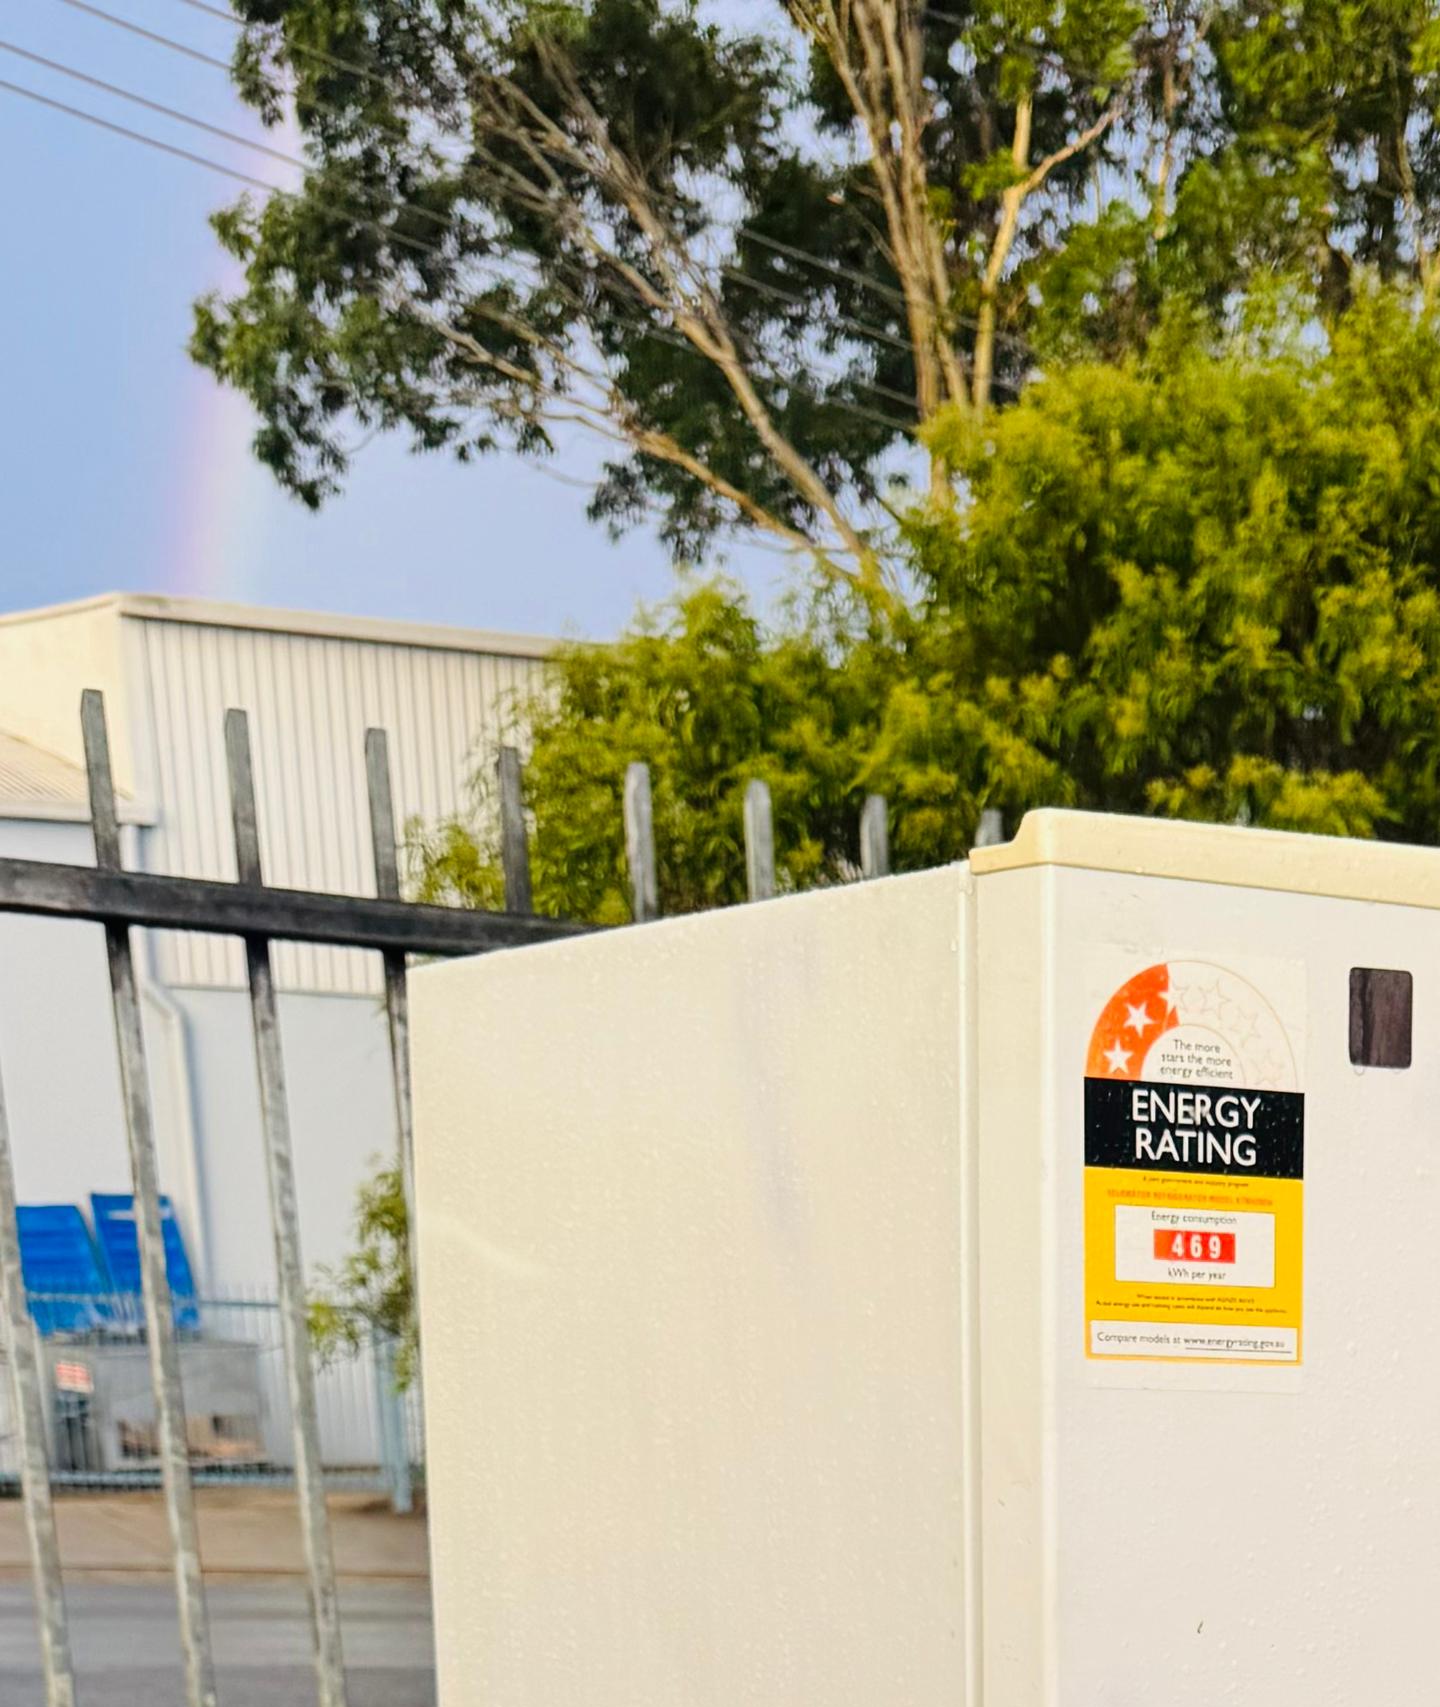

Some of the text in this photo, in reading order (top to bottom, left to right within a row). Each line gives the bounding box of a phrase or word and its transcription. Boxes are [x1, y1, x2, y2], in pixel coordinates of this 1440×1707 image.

[1173, 1039, 1221, 1054] The more
[1161, 1053, 1232, 1067] stars the more
[1160, 1065, 1234, 1080] energy efficient
[1131, 1088, 1262, 1130] ENERGY
[1135, 1126, 1257, 1167] RATING
[1151, 1210, 1238, 1226] Energy consumption
[1191, 1270, 1206, 1281] per
[1208, 1271, 1228, 1281] year
[1096, 1331, 1138, 1344] Compare
[1139, 1333, 1171, 1345] models
[1172, 1336, 1182, 1345] at
